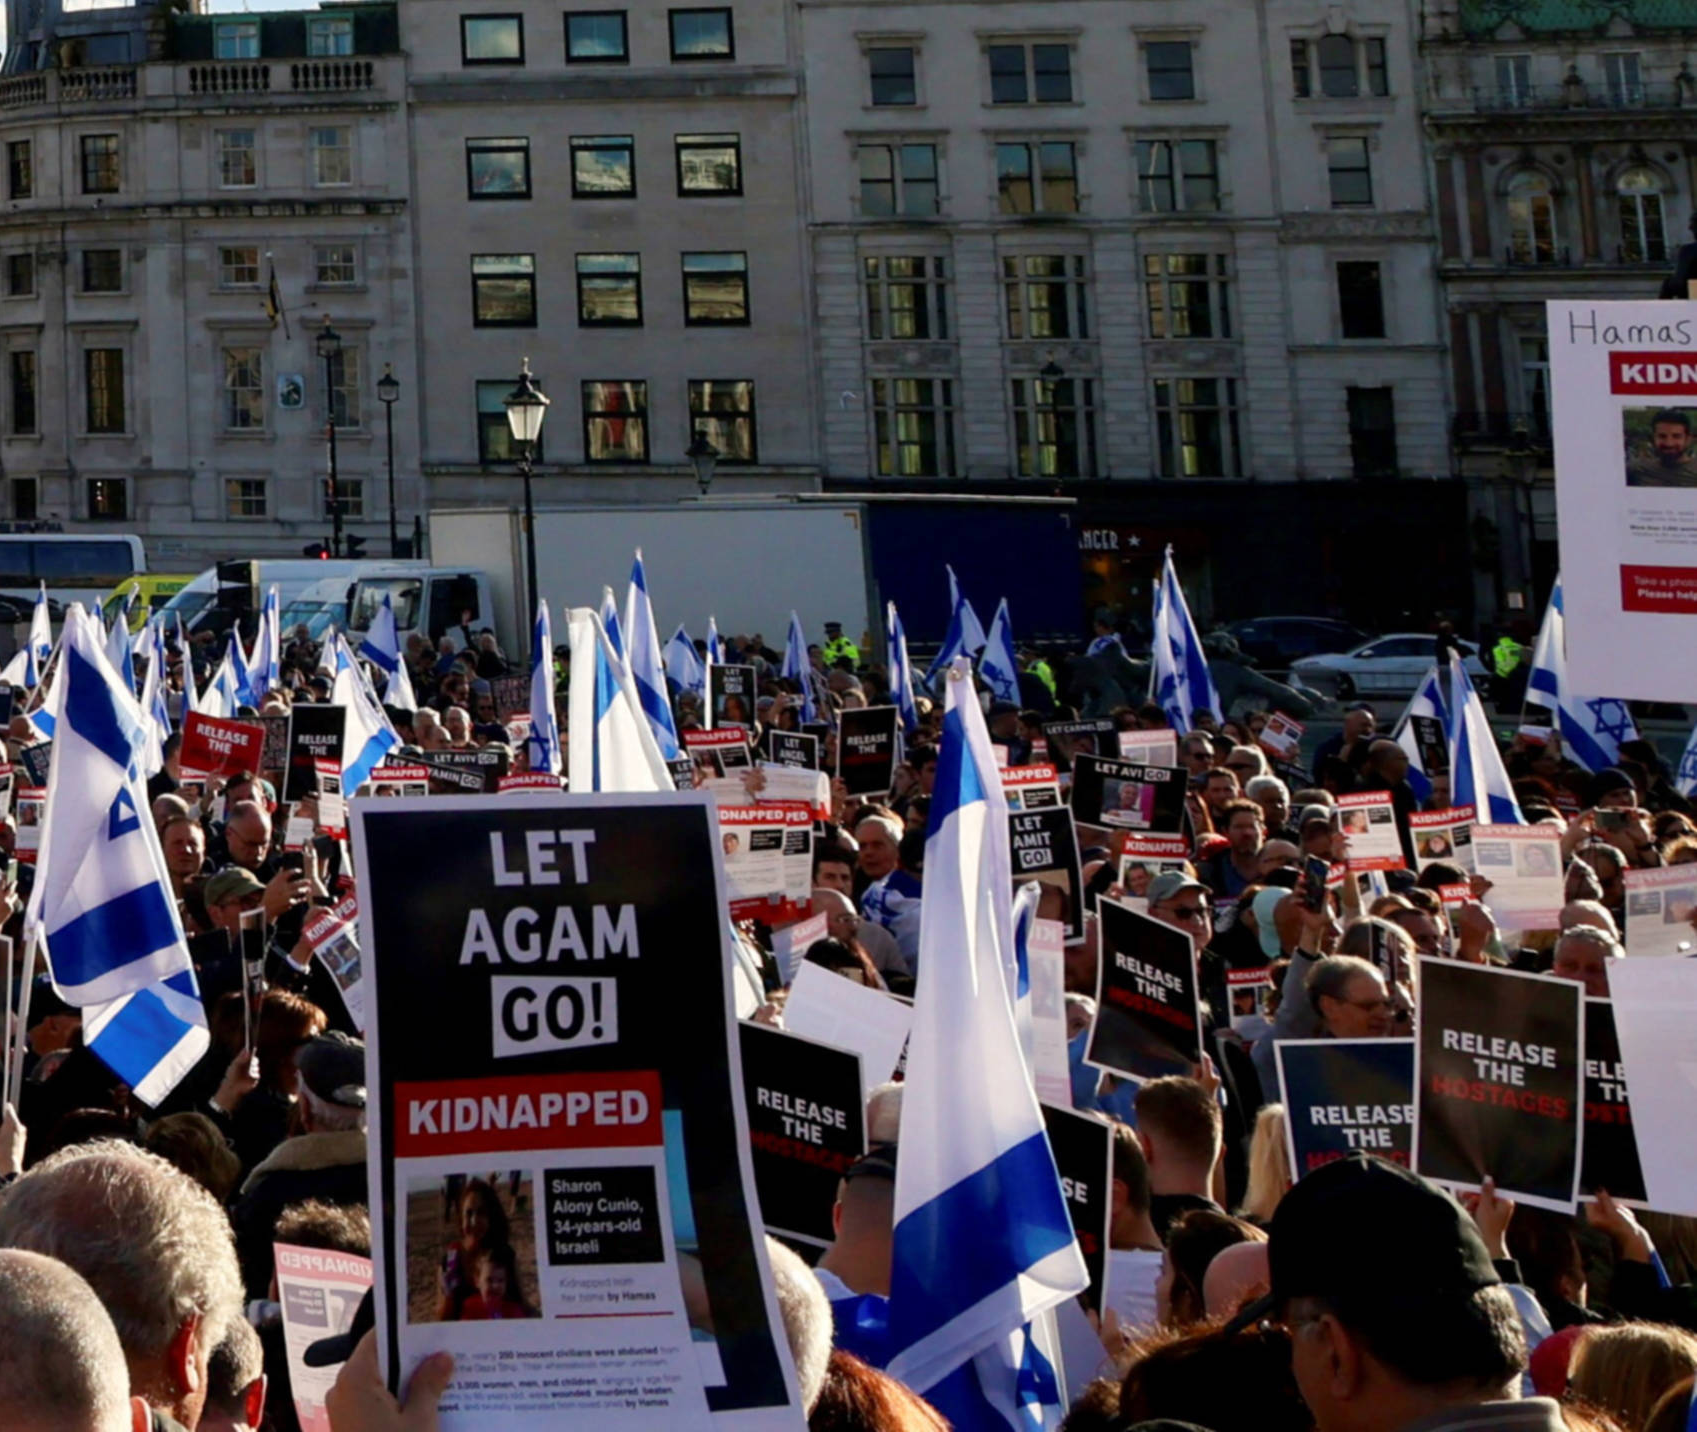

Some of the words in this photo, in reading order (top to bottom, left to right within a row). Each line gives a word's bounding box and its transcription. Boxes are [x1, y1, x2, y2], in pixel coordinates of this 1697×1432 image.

[1568, 309, 1692, 345] Hamas
[1637, 589, 1674, 599] Please
[197, 724, 249, 746] RELEASE
[685, 730, 741, 742] KIDNAPPED
[1047, 725, 1063, 735] LET
[208, 739, 232, 754] THE
[298, 734, 338, 745] RELEASE
[785, 738, 800, 747] LET
[847, 735, 887, 746] RELEASE
[309, 746, 327, 756] THE
[857, 745, 877, 754] THE
[435, 754, 452, 762] LET
[372, 768, 426, 778] KIDNAPPED
[1002, 768, 1052, 782] NAPPED
[1095, 762, 1118, 776] LET
[1120, 765, 1142, 779] AVI
[499, 776, 559, 788] KIDNAPPED
[720, 809, 784, 821] DNAPPED
[1410, 807, 1474, 825] KIDNAPPED
[1014, 816, 1043, 832] LET
[1013, 832, 1052, 848] AMIT
[1125, 840, 1185, 854] KIDNAPPED
[490, 829, 596, 887] LET
[1021, 848, 1051, 867] GO!
[459, 903, 641, 965] AGAM
[1115, 951, 1183, 993] RELEASE
[1135, 976, 1167, 1002] THE
[501, 981, 604, 1043] GO!
[1443, 1029, 1557, 1068] RELEASE
[1473, 1058, 1526, 1087] THE
[1432, 1074, 1569, 1118] HOSTAGES
[409, 1089, 649, 1135] KIDNAPPED
[756, 1086, 847, 1131] RELEASE
[1310, 1104, 1416, 1126] RELEASE
[782, 1115, 823, 1145] THE
[1342, 1127, 1394, 1148] THE
[552, 1178, 602, 1194] Sharon
[553, 1199, 594, 1216] Alony
[596, 1198, 644, 1214] Cunio,
[554, 1219, 642, 1235] 34-years-old
[555, 1239, 600, 1254] Israeli
[606, 1292, 620, 1305] by
[622, 1290, 656, 1301] Hamas
[617, 1346, 658, 1356] abducted
[542, 1377, 559, 1387] and
